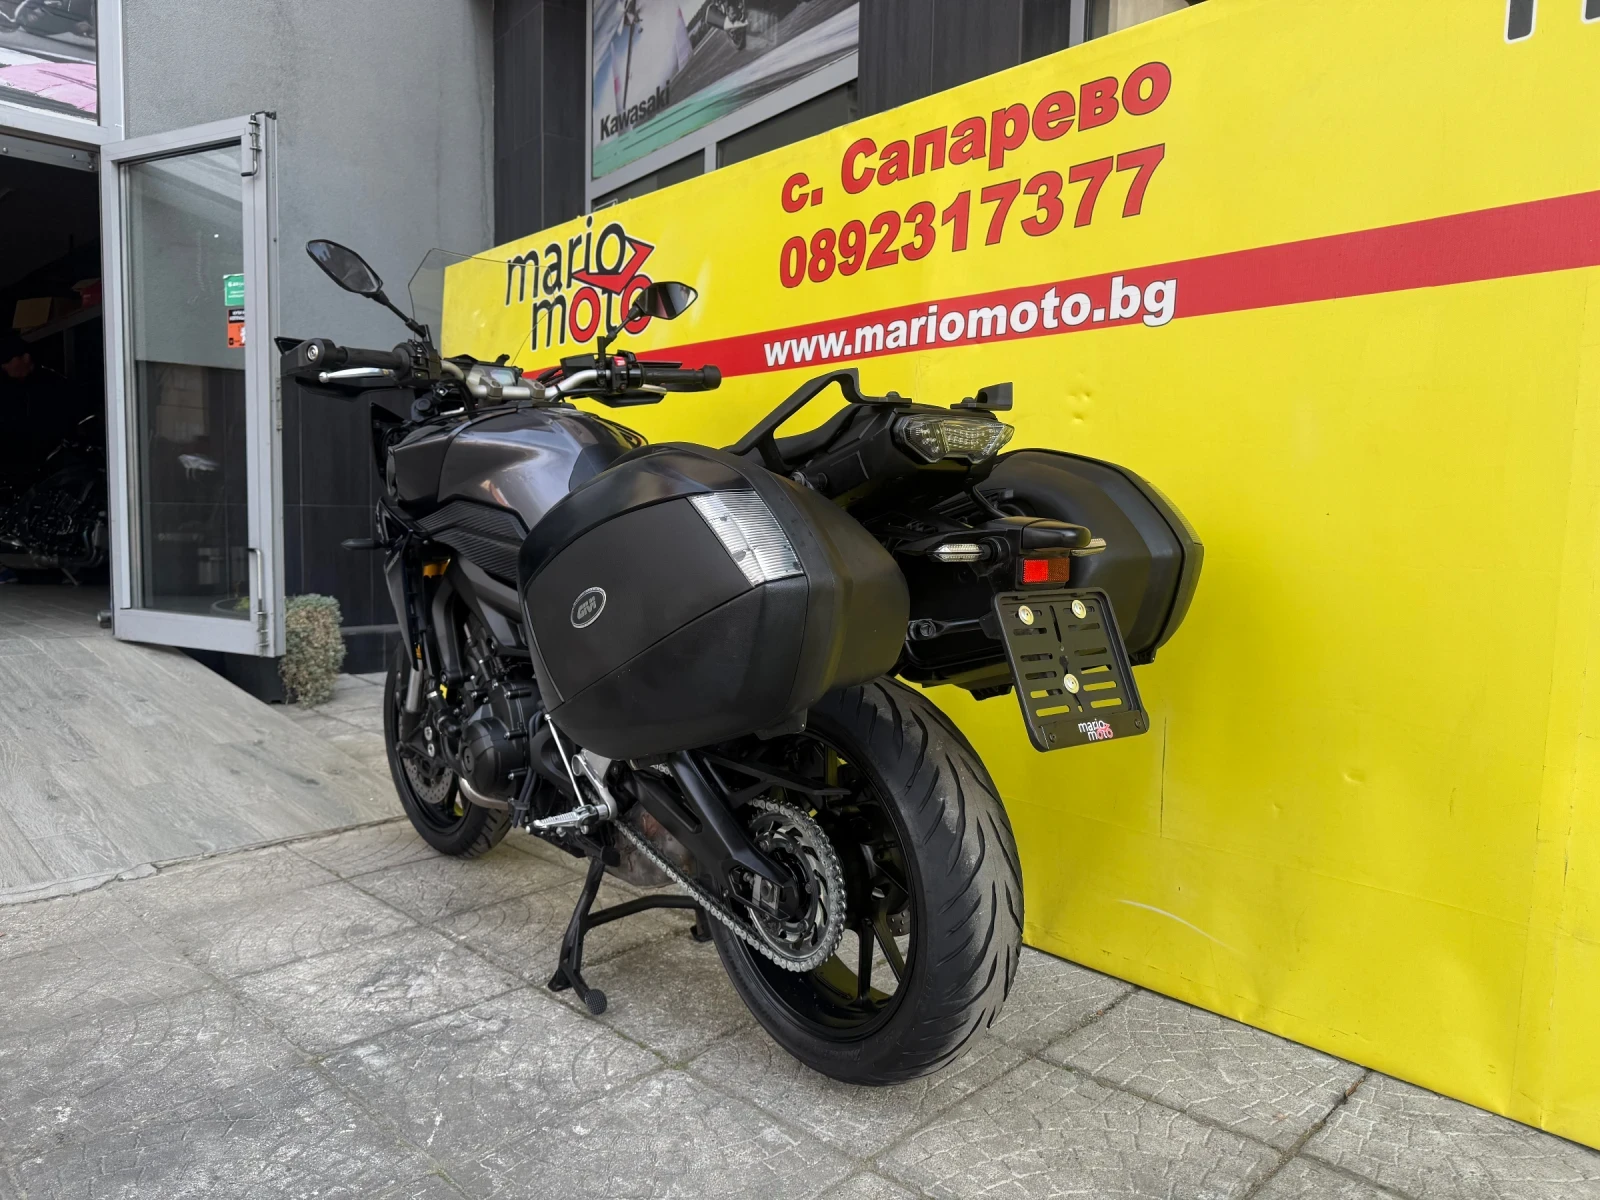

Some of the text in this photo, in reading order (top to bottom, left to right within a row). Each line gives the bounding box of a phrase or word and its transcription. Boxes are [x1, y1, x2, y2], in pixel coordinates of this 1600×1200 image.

[600, 79, 670, 141] Kawasaki
[781, 61, 1172, 213] с. Сапарево
[779, 143, 1165, 288] 0892317377
[505, 215, 627, 306] mario
[531, 274, 655, 351] moto
[764, 276, 1178, 367] www.mariomoto.bg
[1078, 718, 1106, 733] mario
[1087, 728, 1113, 741] moto
